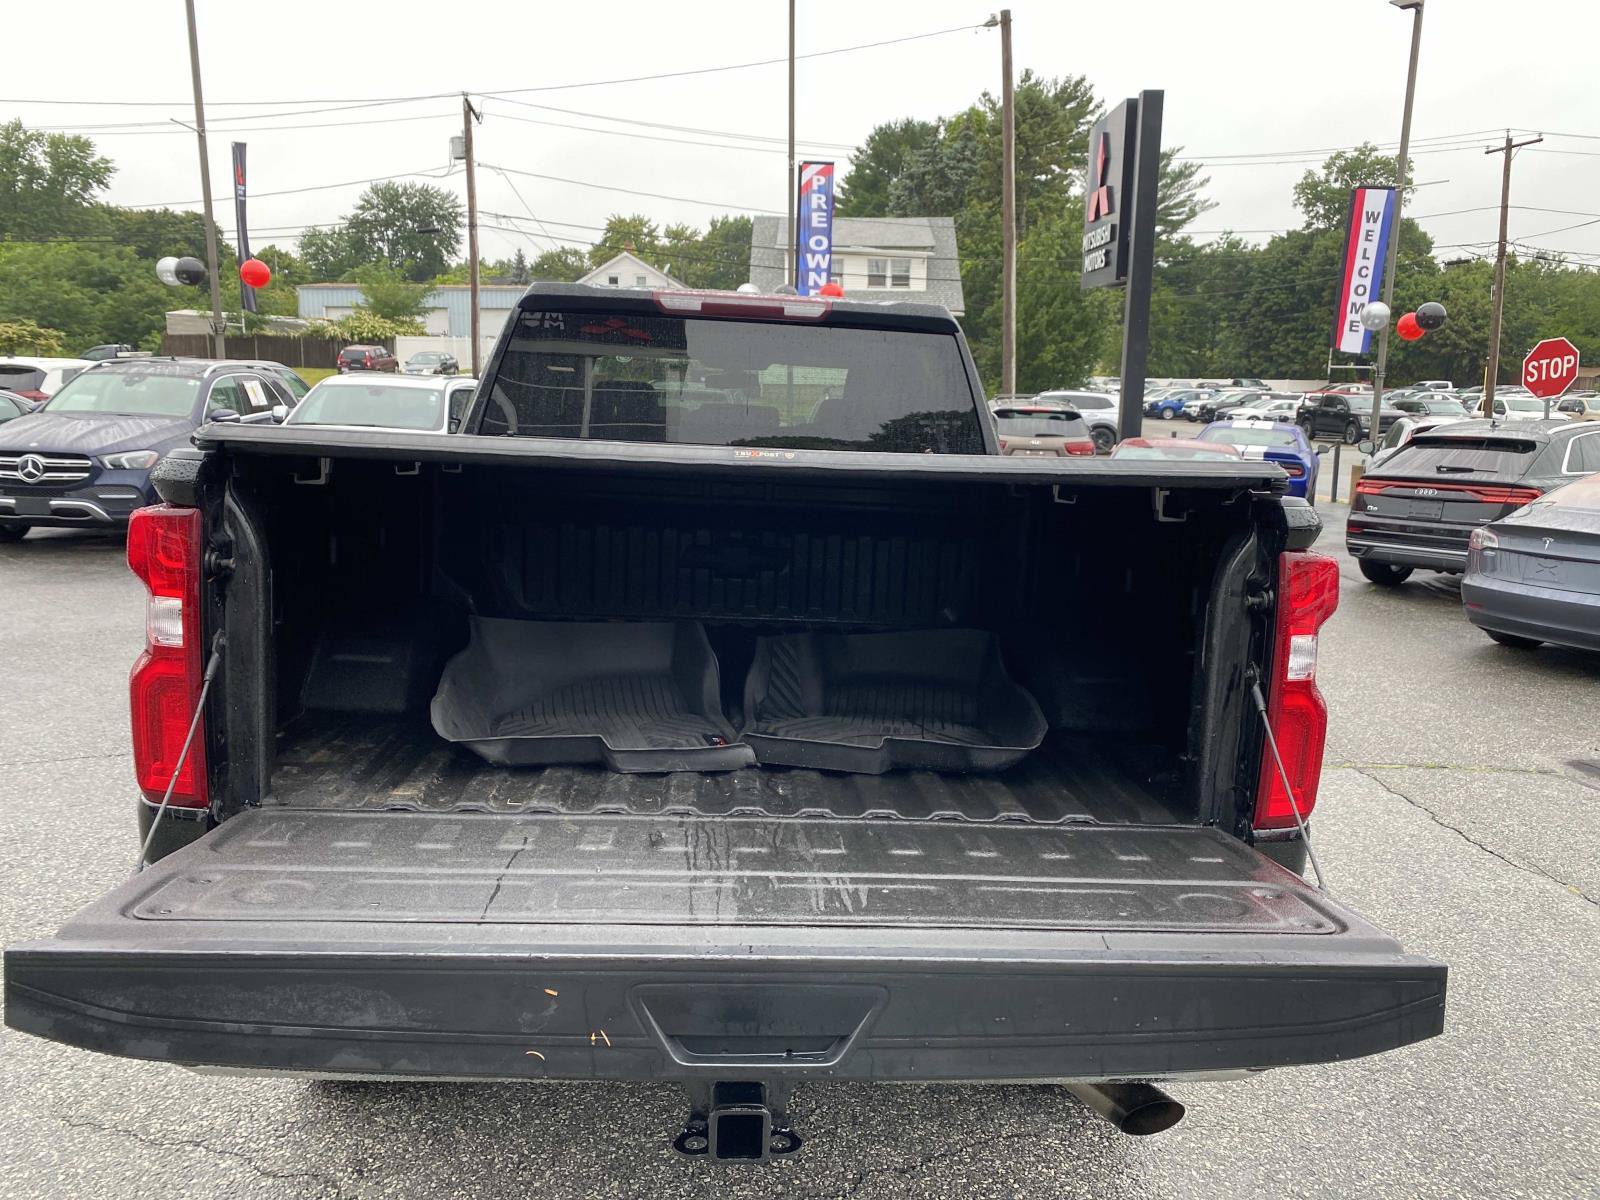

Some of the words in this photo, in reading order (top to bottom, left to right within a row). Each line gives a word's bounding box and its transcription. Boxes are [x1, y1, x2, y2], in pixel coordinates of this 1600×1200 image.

[811, 174, 828, 228] PRE
[1083, 248, 1106, 273] MOTORS
[1348, 210, 1381, 333] WELCOME
[1526, 355, 1575, 383] STOP
